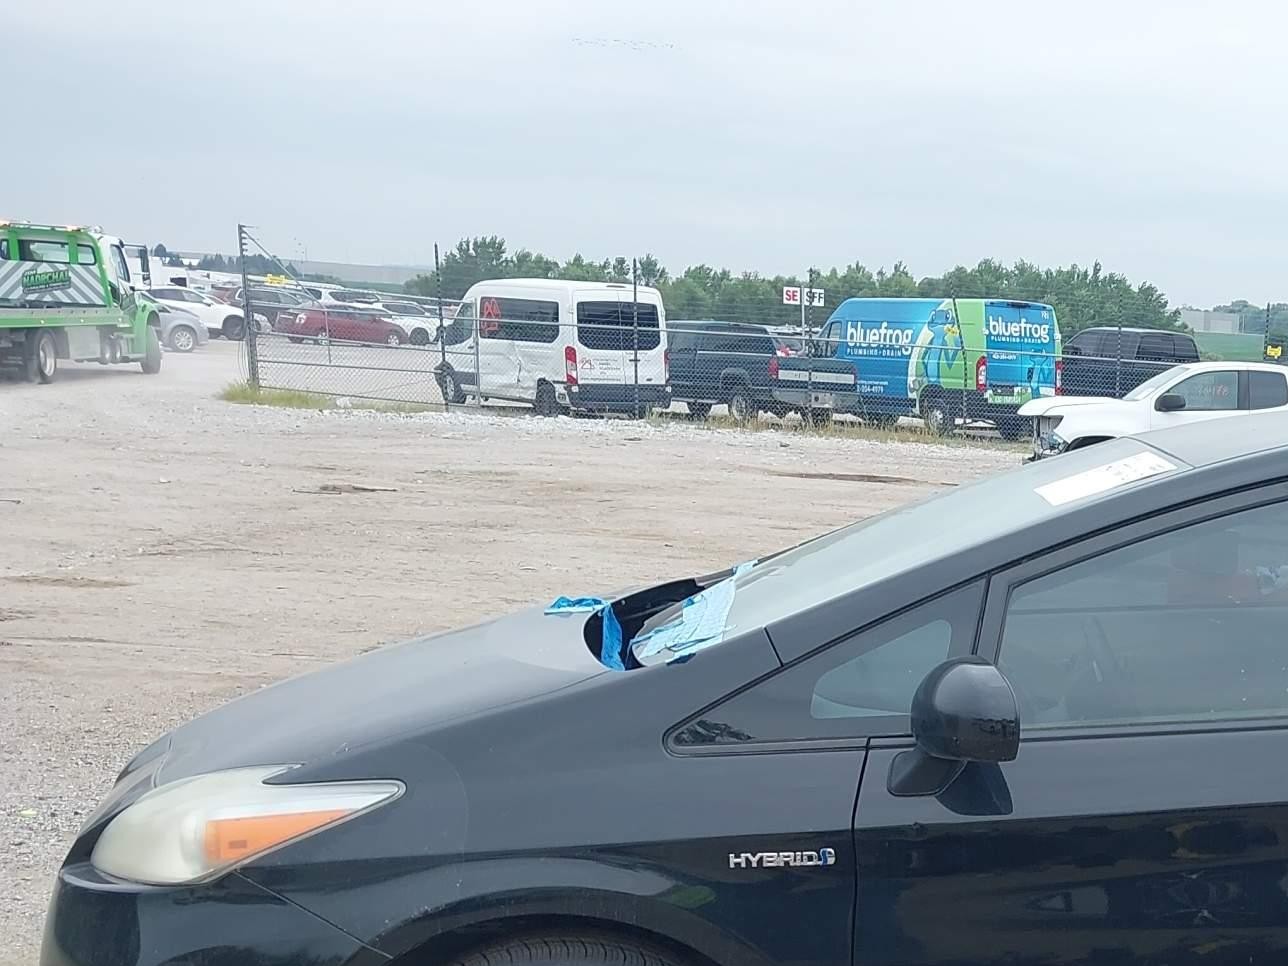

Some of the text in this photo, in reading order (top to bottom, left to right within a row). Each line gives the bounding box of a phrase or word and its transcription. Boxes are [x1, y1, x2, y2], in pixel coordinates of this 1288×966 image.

[785, 289, 799, 302] SE
[847, 321, 914, 356] bluefrog
[989, 315, 1050, 344] bluefrog
[729, 851, 819, 869] HYBRID
